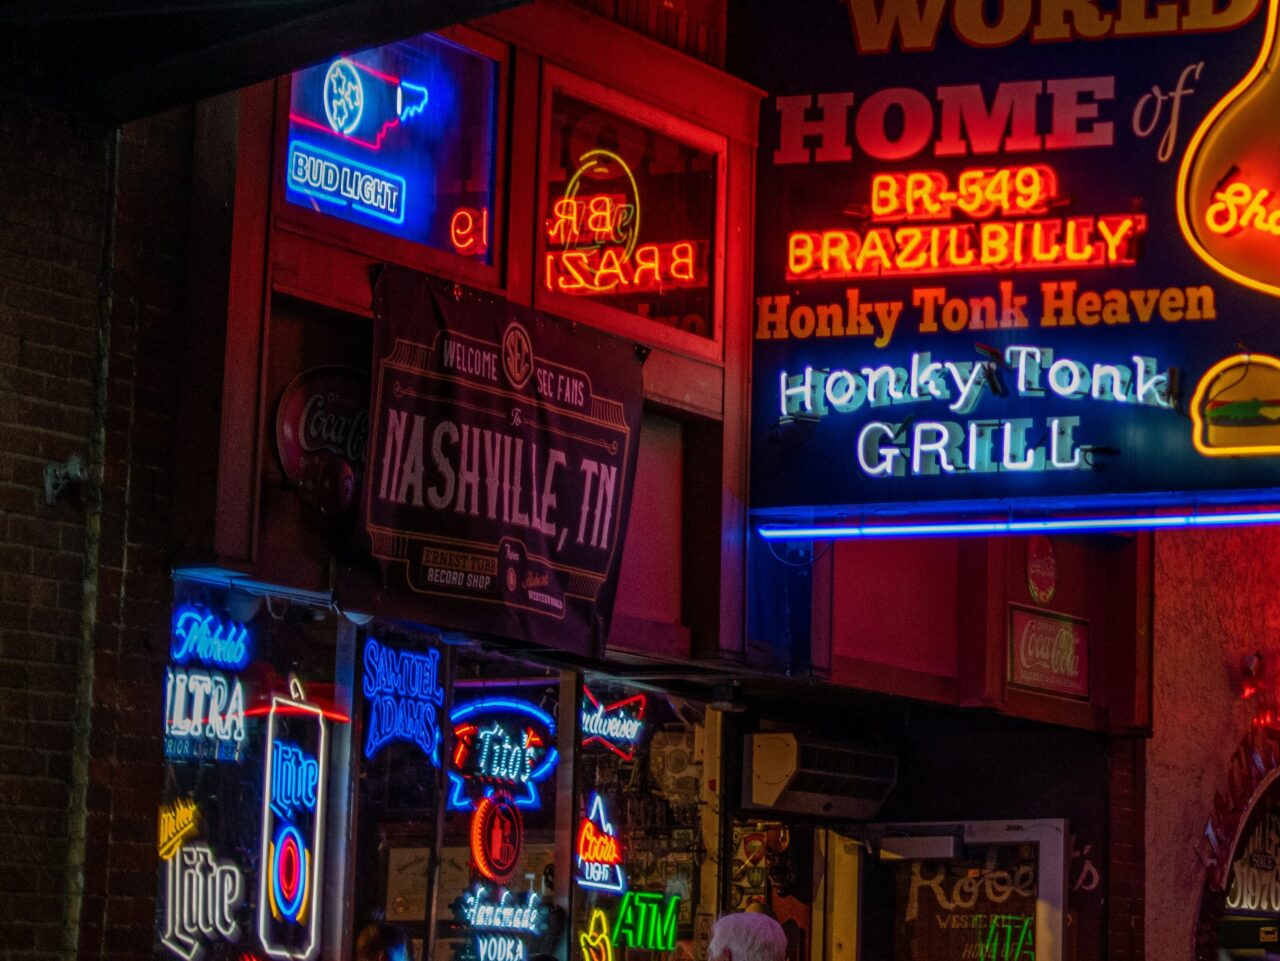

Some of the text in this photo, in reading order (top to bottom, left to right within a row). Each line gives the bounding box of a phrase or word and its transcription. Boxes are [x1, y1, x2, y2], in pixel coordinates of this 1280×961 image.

[772, 61, 1205, 165] HOME of
[291, 150, 399, 214] BUD LIGHT
[871, 165, 1055, 221] BR-549
[787, 213, 1146, 279] BRAZILBILLY
[754, 290, 902, 347] Honky
[913, 283, 1028, 334] Tonk
[1040, 280, 1216, 330] Heaven
[442, 337, 500, 382] WELCOME
[536, 368, 586, 407] SEC FANS
[778, 344, 1176, 416] Honky Tonk
[857, 415, 1083, 478] GRILL
[377, 407, 618, 552] NASHVILLE, TN
[424, 550, 468, 570] ERNEST
[427, 567, 491, 590] RECORD SHOP
[363, 638, 444, 707] SAMUEL
[365, 693, 442, 761] ADAMS
[478, 721, 537, 782] Tito's
[582, 704, 642, 739] udweiser
[271, 740, 319, 823] Lite
[161, 843, 241, 960] Lite
[611, 891, 681, 951] ATM
[478, 936, 525, 961] VODKA
